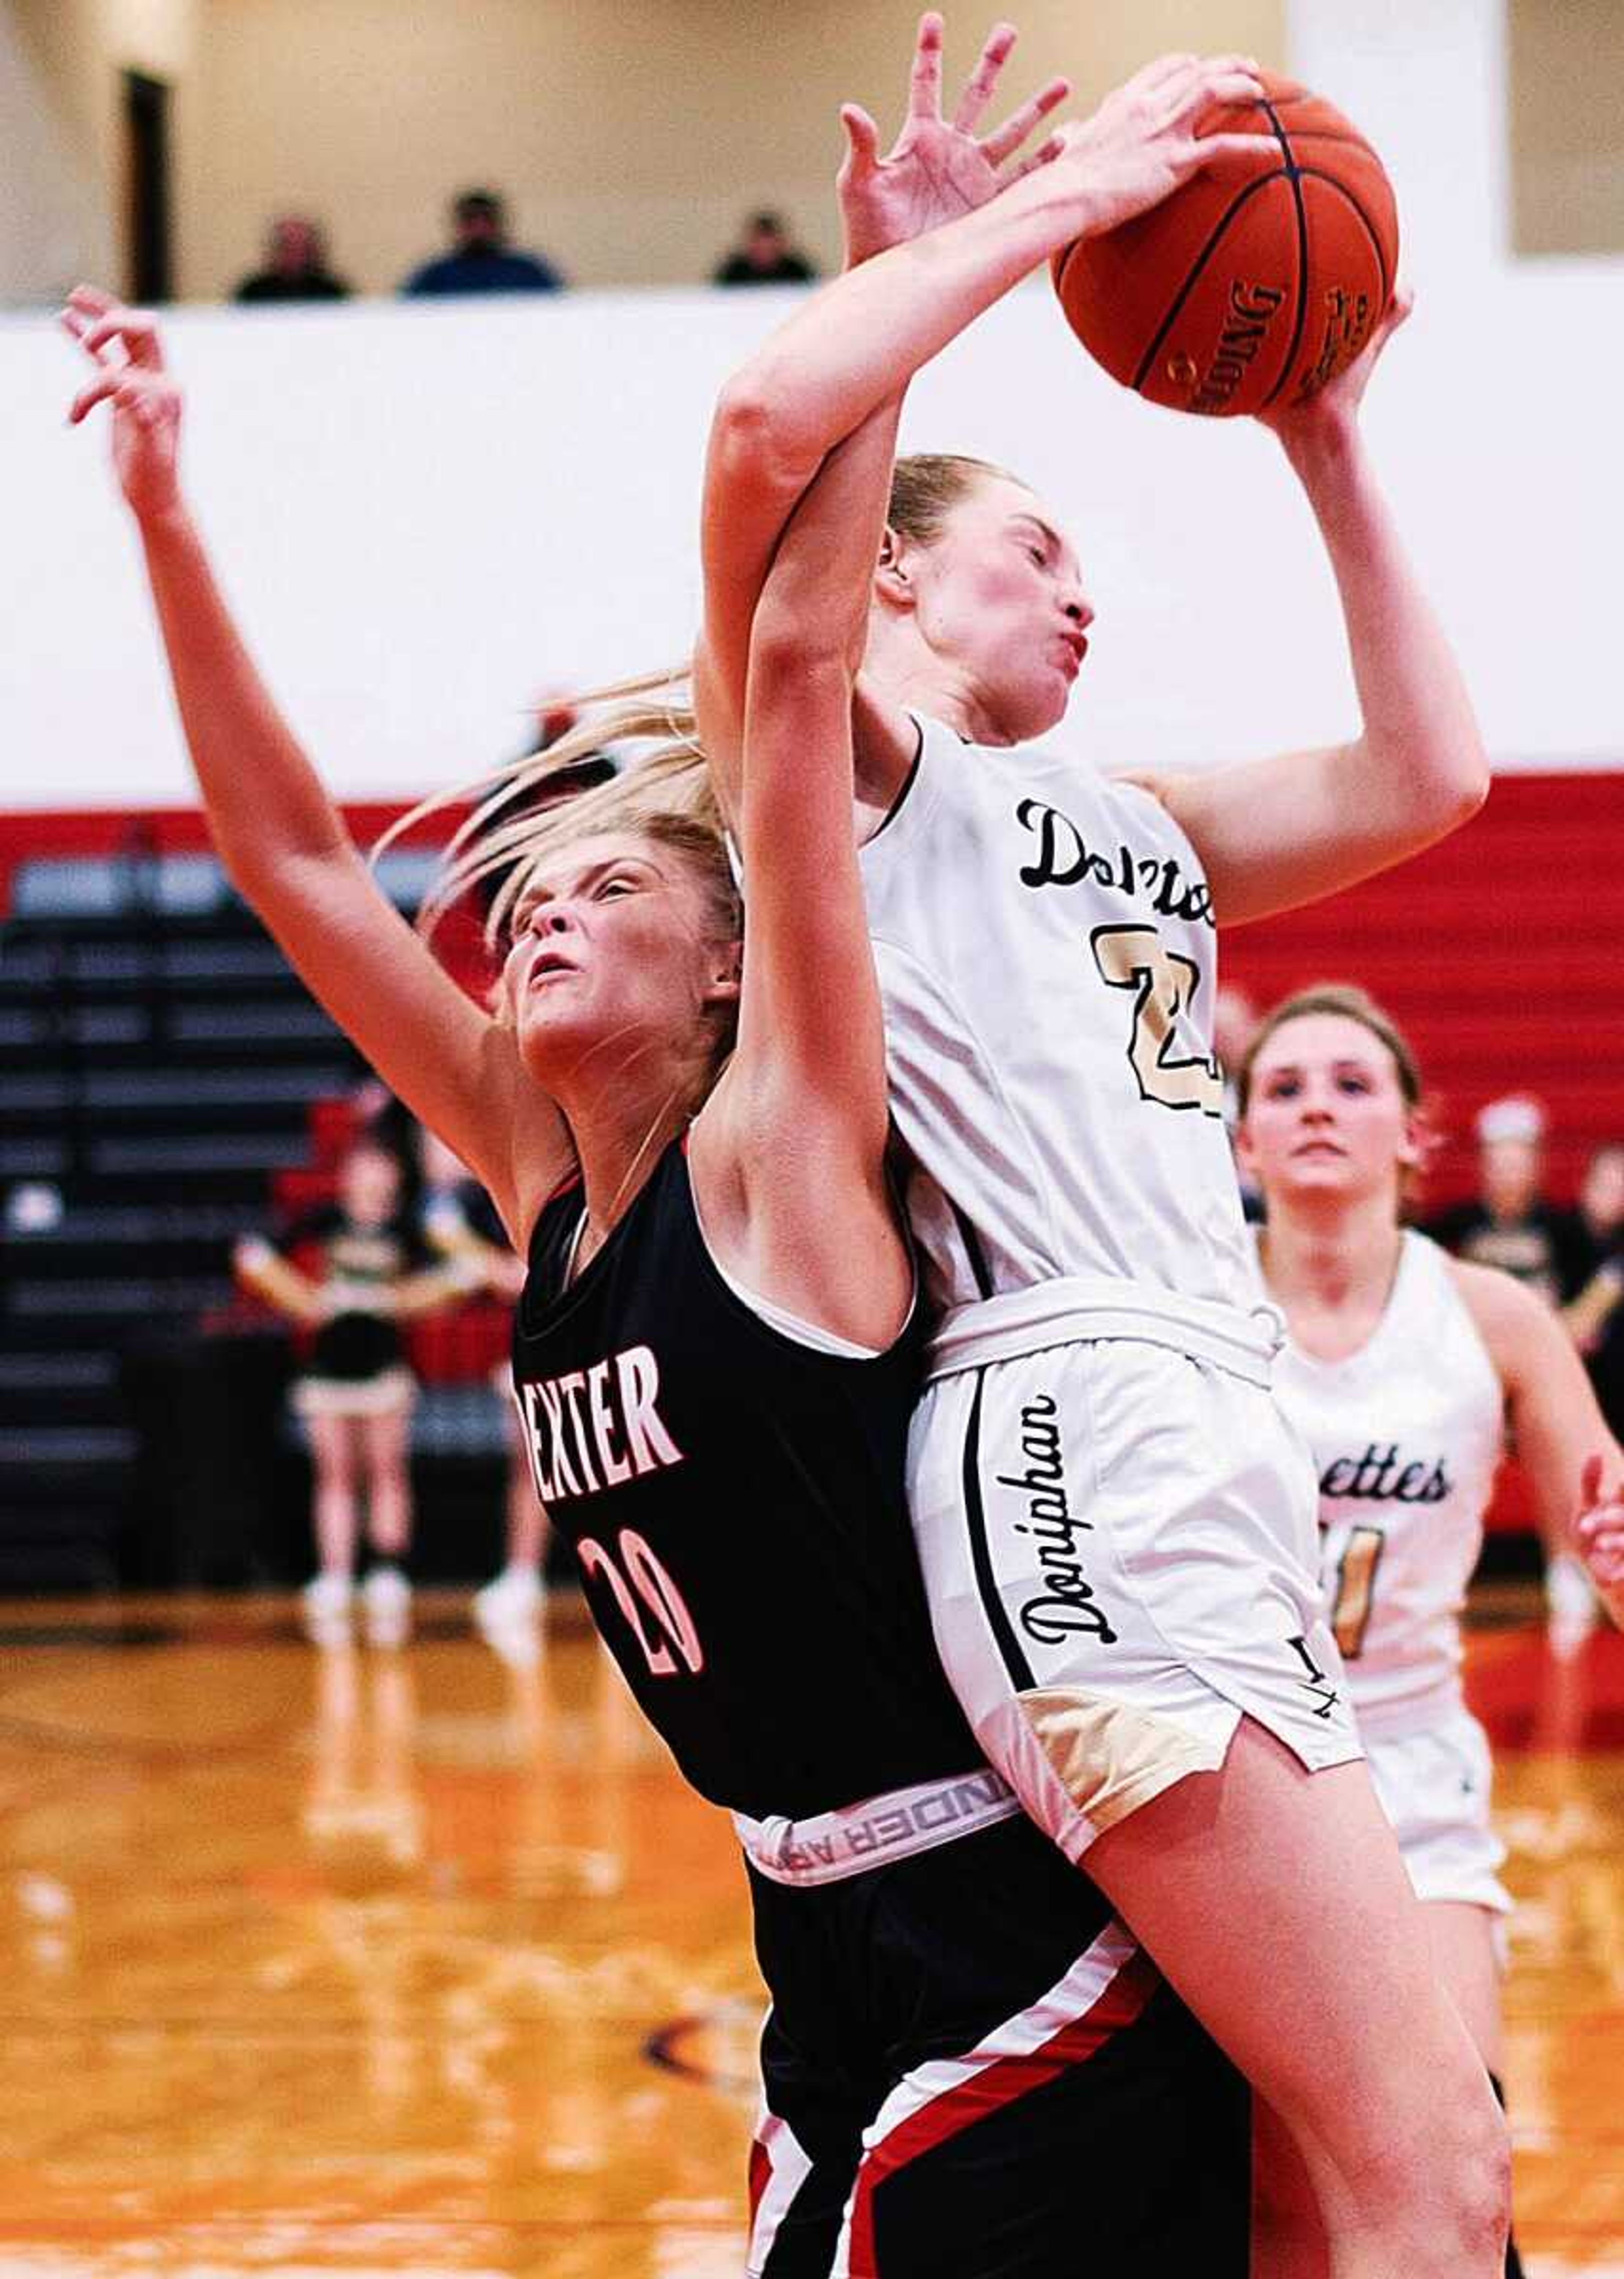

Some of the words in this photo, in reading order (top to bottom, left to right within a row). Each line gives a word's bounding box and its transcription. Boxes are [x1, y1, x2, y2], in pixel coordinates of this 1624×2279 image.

[519, 1344, 684, 1502] EXTER
[997, 1394, 1118, 1645] Doniphan
[1318, 1521, 1385, 1660] 1
[577, 1528, 705, 1675] 20
[846, 1774, 1002, 1855] NDER
